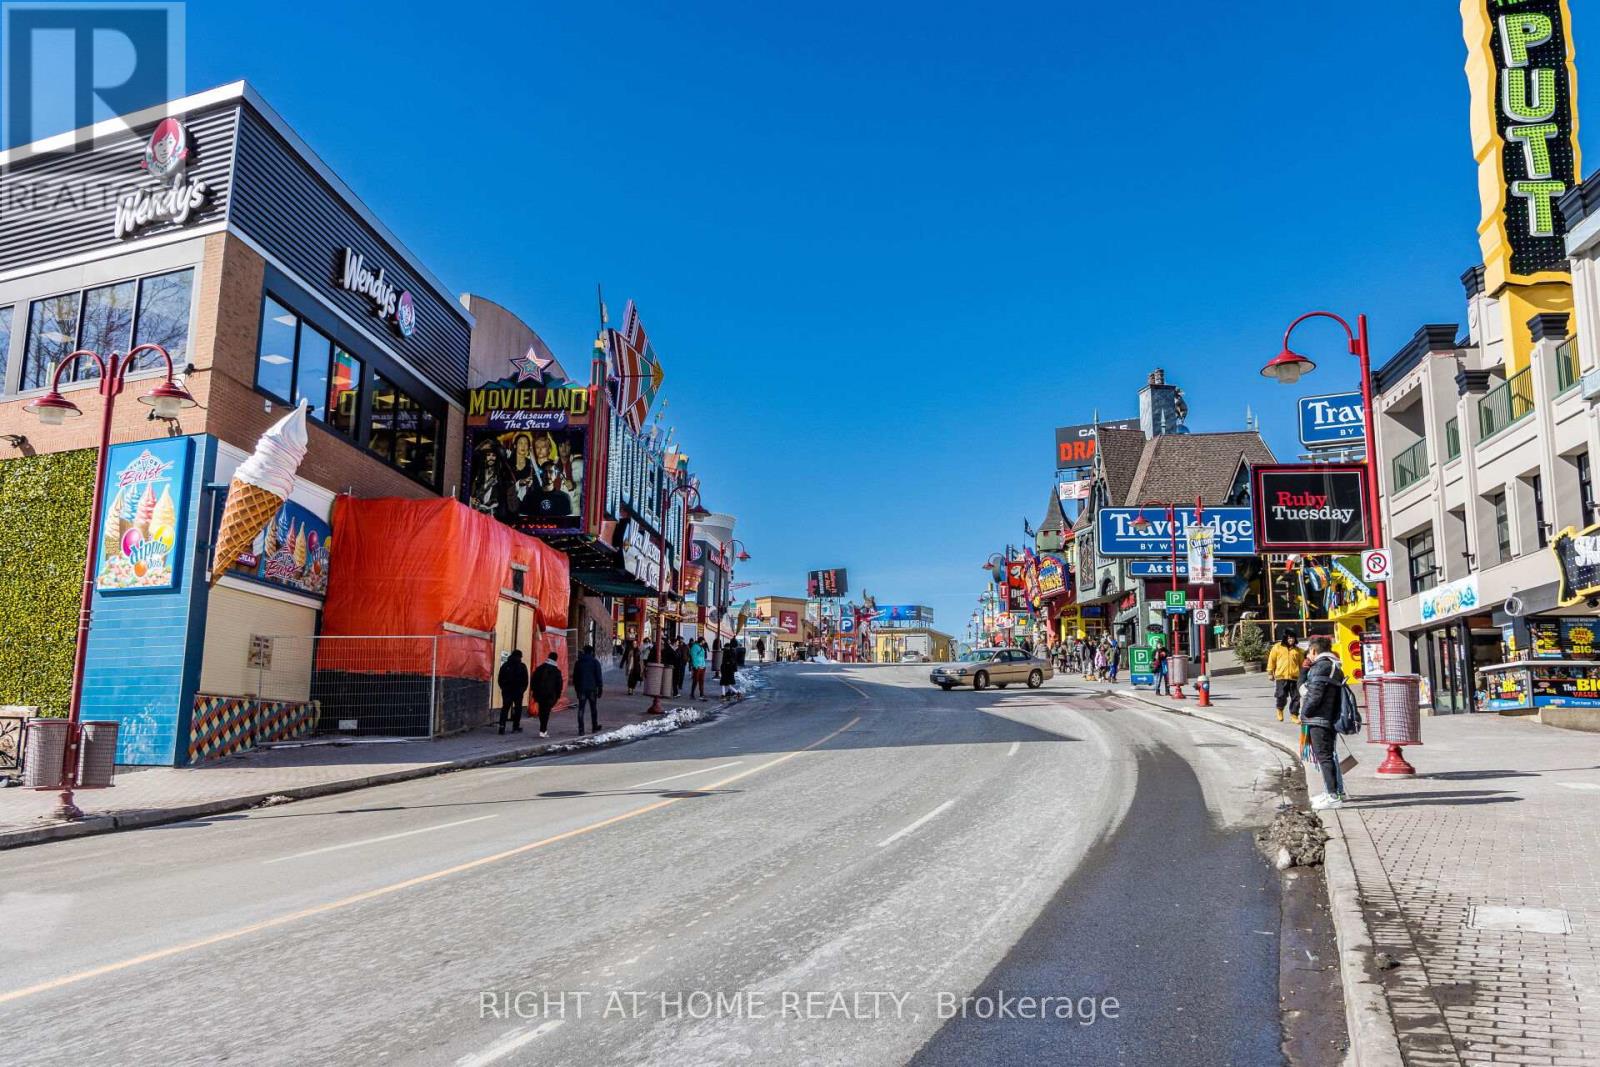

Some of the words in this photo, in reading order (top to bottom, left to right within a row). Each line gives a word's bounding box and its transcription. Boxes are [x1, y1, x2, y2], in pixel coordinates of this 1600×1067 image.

[1499, 13, 1565, 237] PUTT
[114, 173, 207, 240] Wendy's
[344, 246, 396, 318] Wendy's
[469, 388, 588, 415] MOVIELAND
[490, 411, 512, 421] Wax
[512, 411, 553, 421] Museum
[553, 410, 566, 422] of
[504, 420, 521, 430] The
[522, 420, 551, 430] Stars
[1276, 491, 1328, 510] Ruby
[1272, 506, 1354, 524] Tuesday
[1110, 512, 1253, 543] Traveldge
[1147, 564, 1163, 573] At
[1563, 683, 1577, 692] The
[1577, 678, 1600, 691] BI
